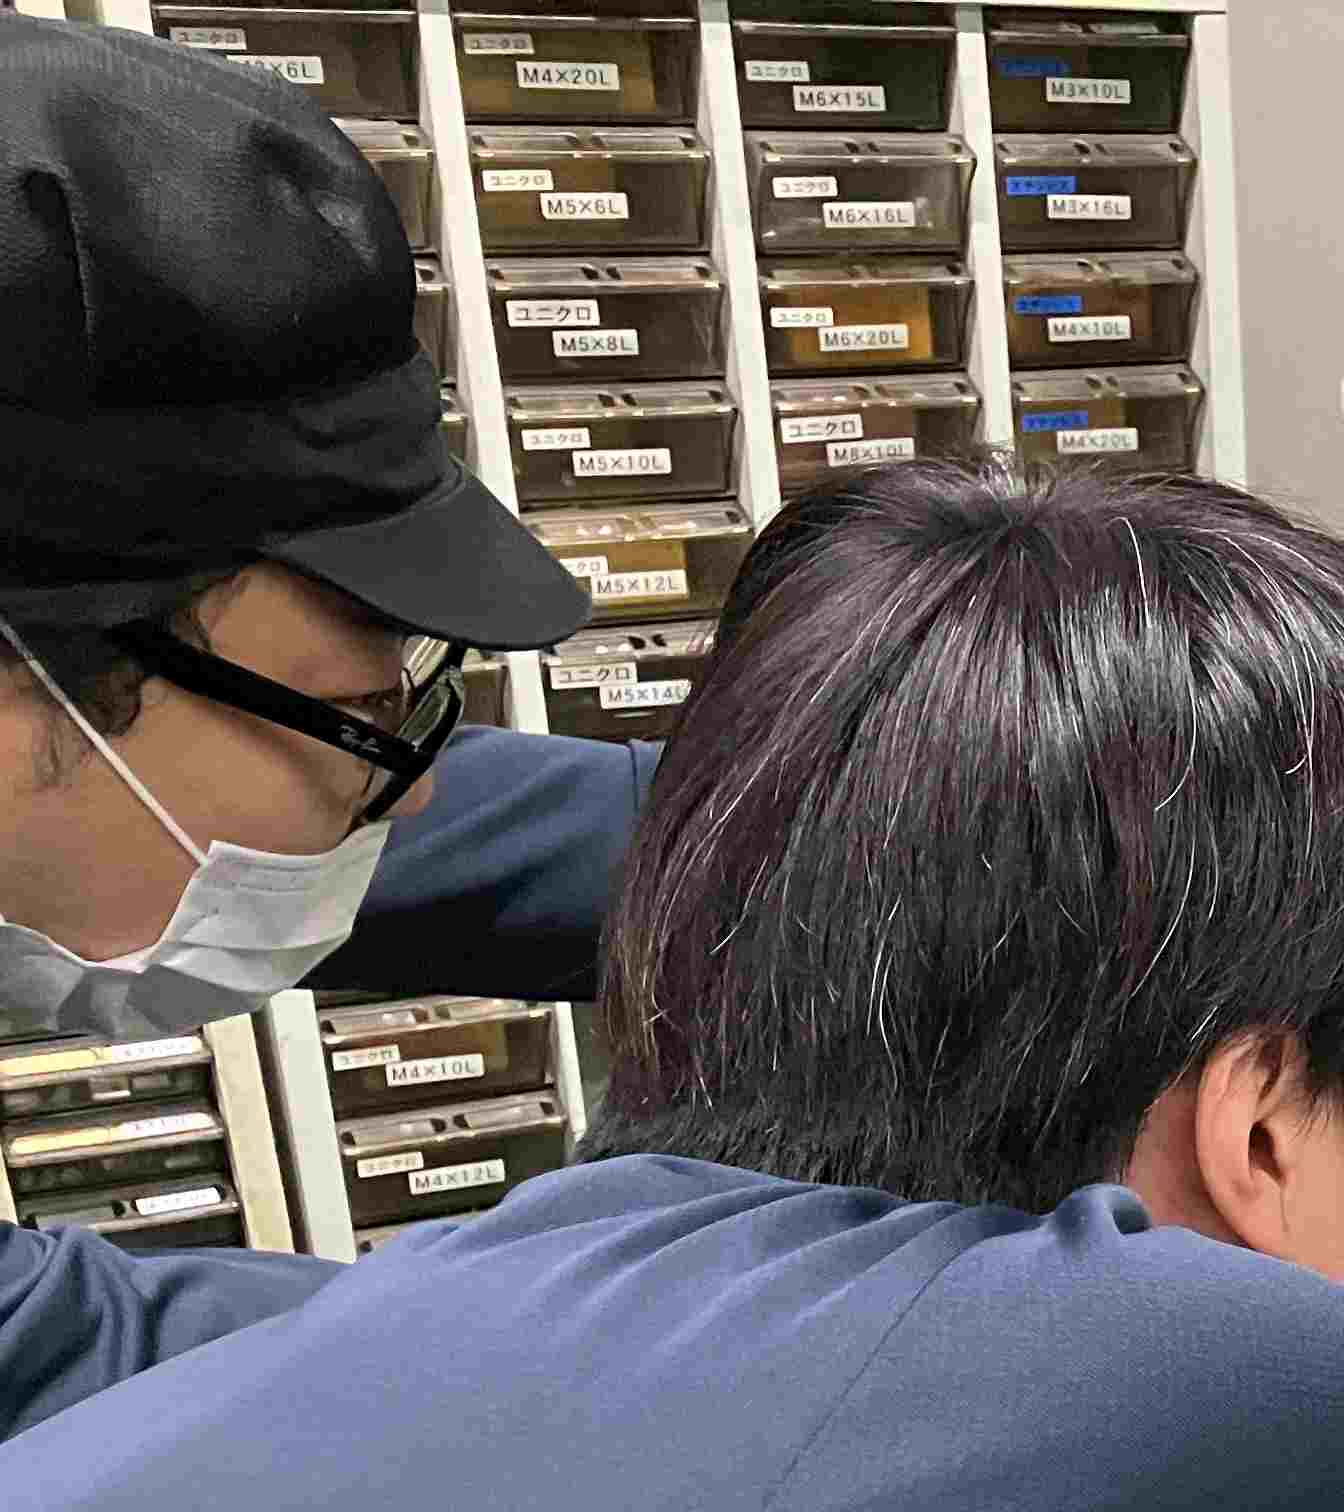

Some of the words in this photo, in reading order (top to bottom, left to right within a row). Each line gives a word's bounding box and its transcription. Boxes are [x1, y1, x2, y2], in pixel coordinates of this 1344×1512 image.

[488, 174, 546, 188] ユニクロ
[514, 305, 592, 323] ユニクロ
[776, 312, 828, 324] ユニクロ
[788, 418, 857, 438] ユニクロ
[558, 666, 631, 683] ユニクロ
